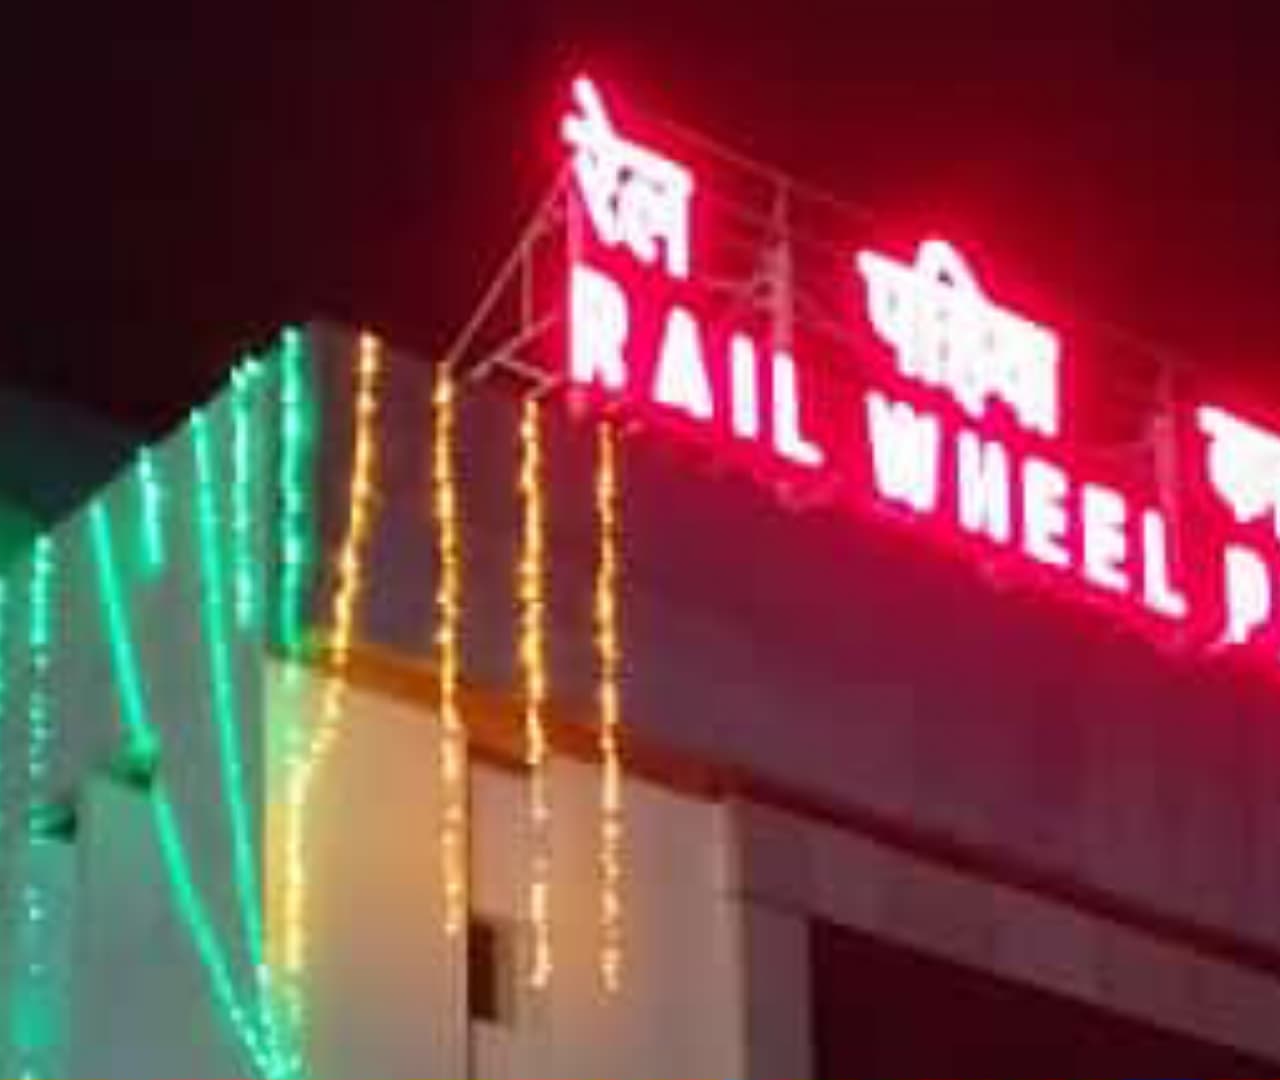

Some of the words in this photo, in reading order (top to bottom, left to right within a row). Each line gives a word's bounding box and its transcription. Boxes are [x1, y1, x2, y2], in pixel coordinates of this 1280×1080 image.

[562, 76, 694, 278] रेल
[857, 238, 1060, 437] पहिया
[570, 260, 823, 466] RAIL
[866, 391, 1187, 617] WHEEL
